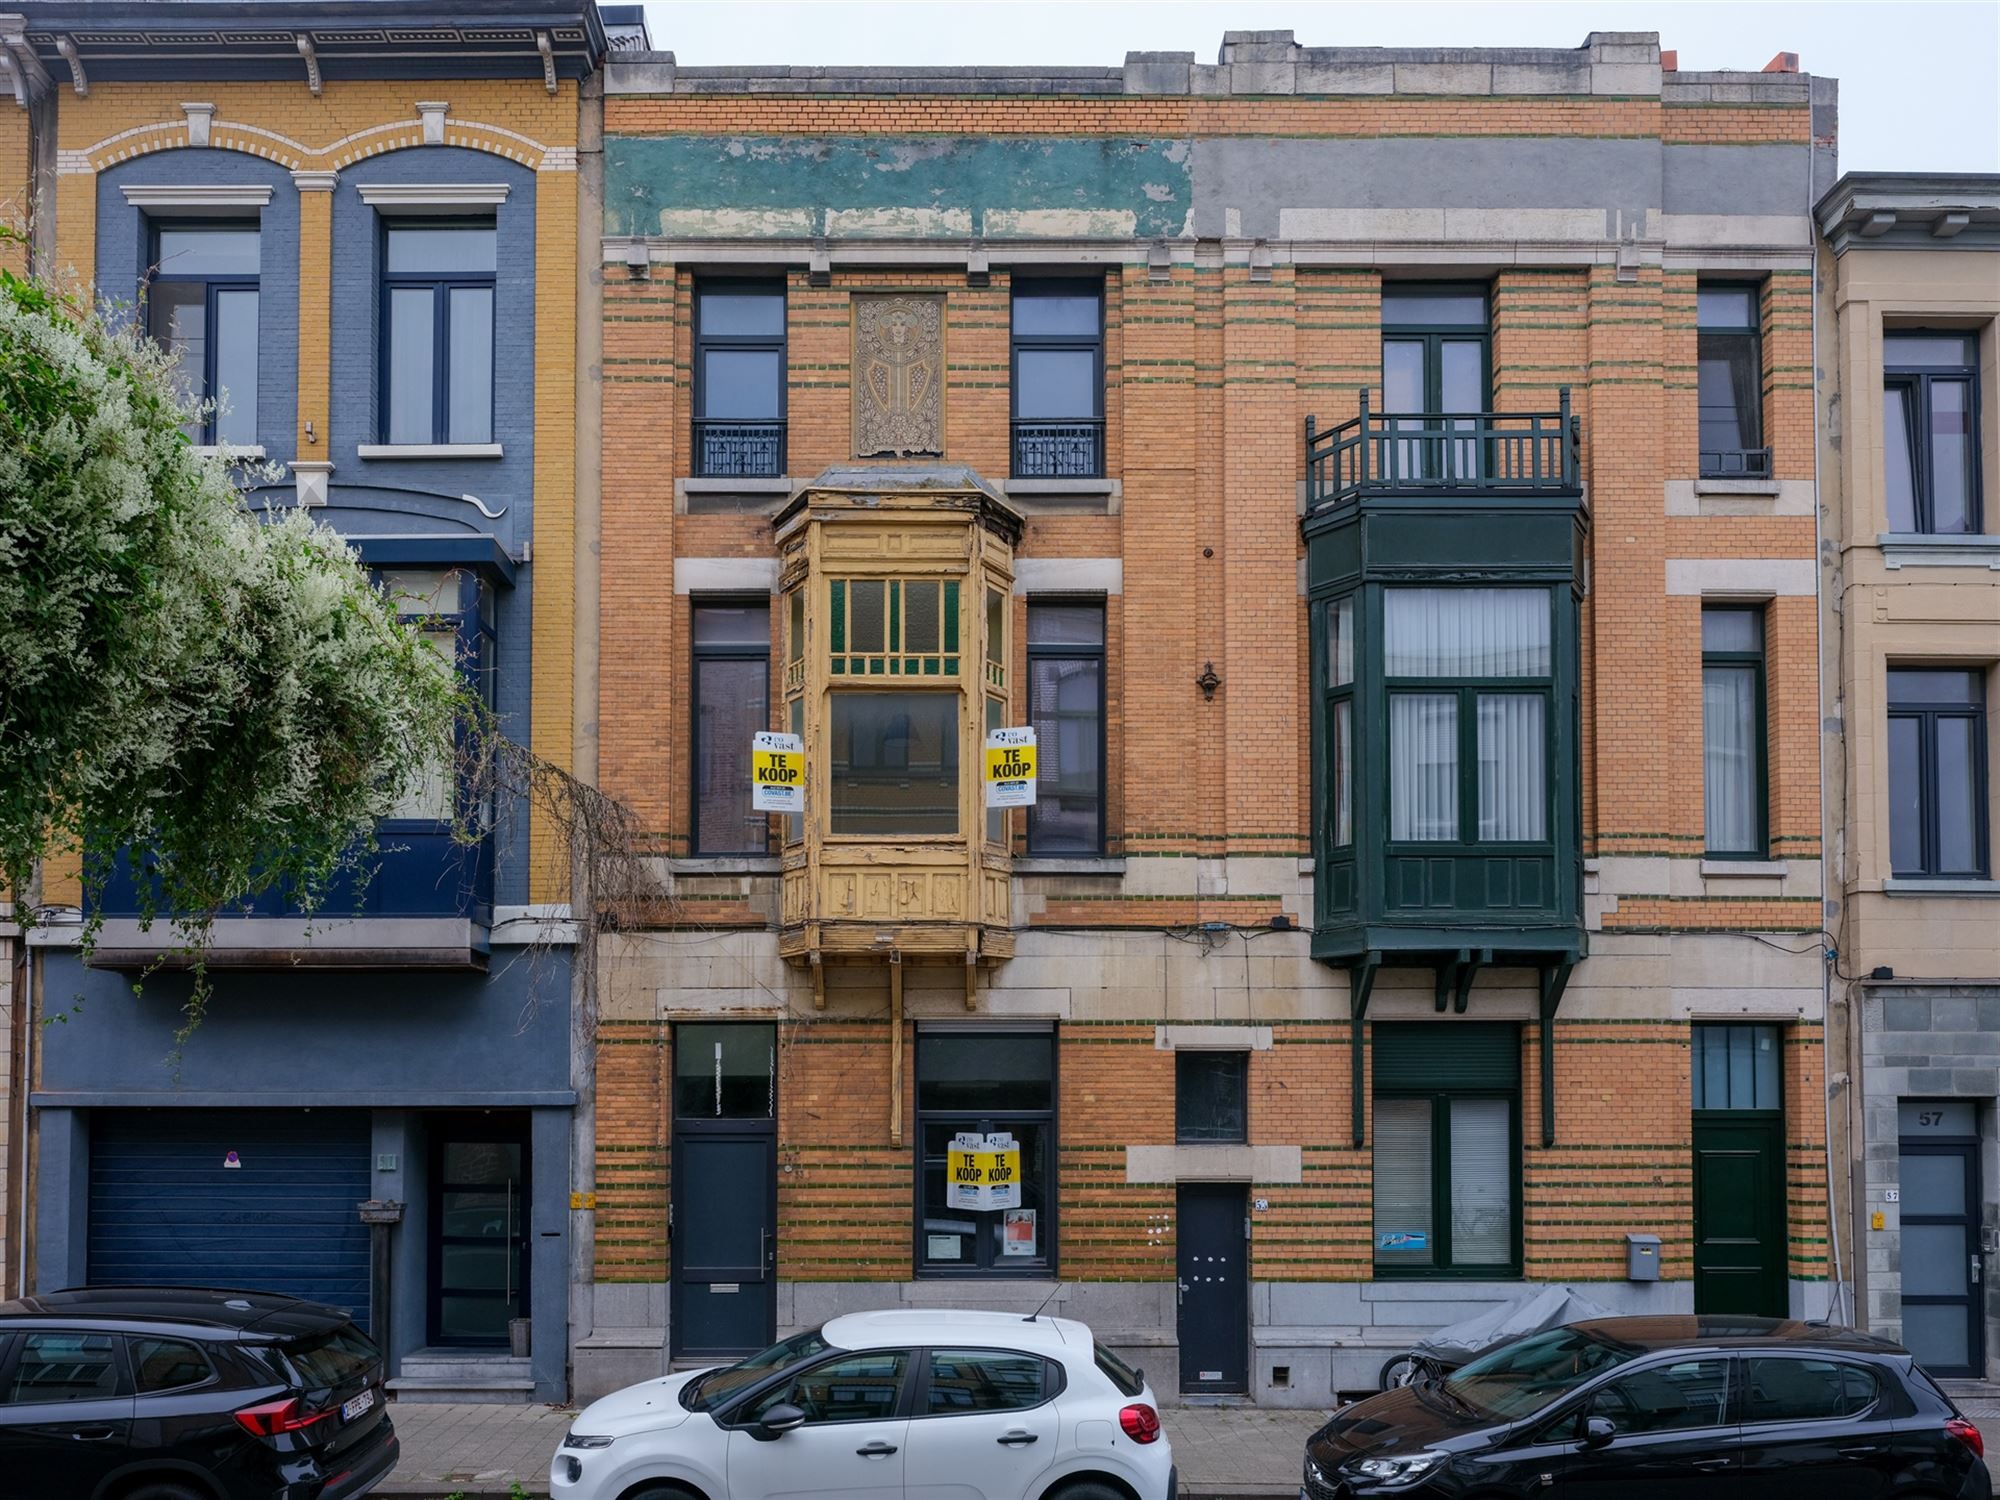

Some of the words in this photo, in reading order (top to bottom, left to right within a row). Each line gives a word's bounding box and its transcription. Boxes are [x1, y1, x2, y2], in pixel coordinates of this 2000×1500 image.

[774, 741, 794, 750] vast
[1008, 736, 1027, 744] vast
[769, 754, 787, 768] TE
[1003, 749, 1020, 763] TE
[758, 767, 798, 782] KOOP
[993, 762, 1031, 778] KOOP
[1919, 1111, 1943, 1126] 57
[963, 1154, 975, 1167] TE
[995, 1154, 1005, 1167] TE
[956, 1167, 982, 1182] KOOP
[988, 1167, 1012, 1182] KOOP
[1887, 1192, 1898, 1200] 57
